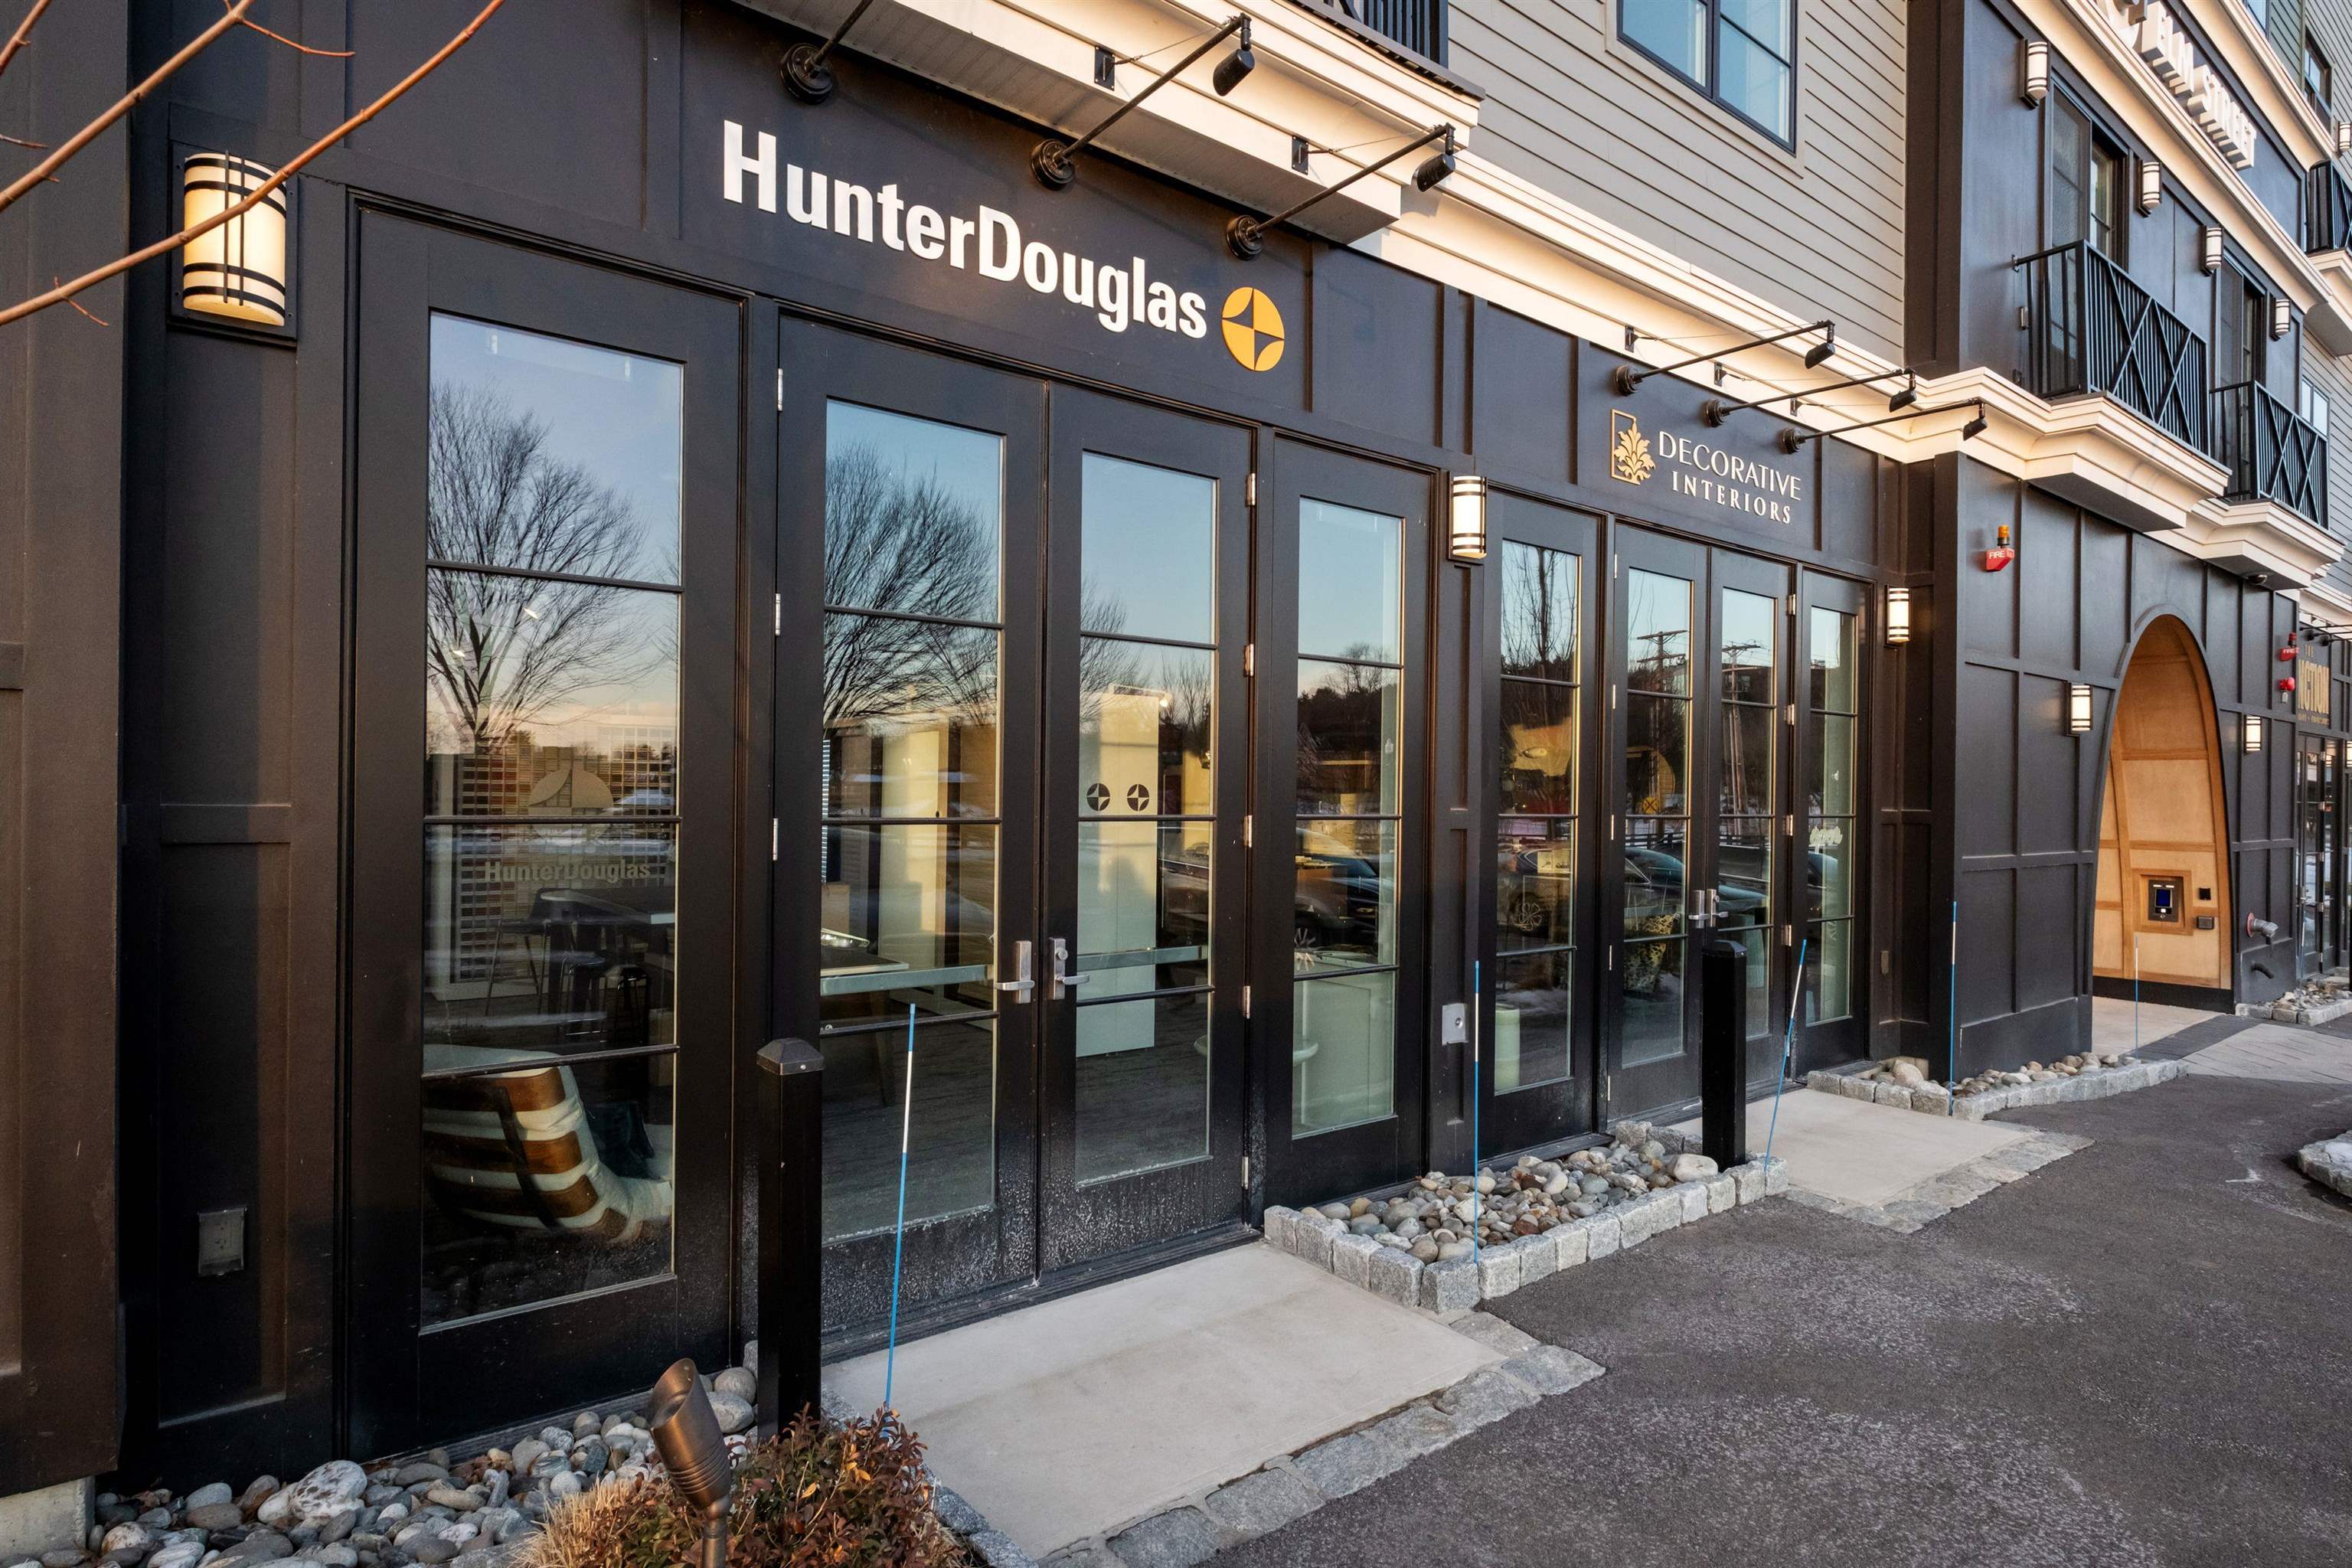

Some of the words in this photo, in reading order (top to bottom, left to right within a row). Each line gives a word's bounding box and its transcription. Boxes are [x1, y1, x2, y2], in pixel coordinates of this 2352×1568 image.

[723, 119, 1207, 338] HunterDouglas
[1659, 430, 1802, 501] DECORATIVE
[1671, 471, 1791, 524] INTERIORS
[485, 861, 651, 883] HunterDouglas
